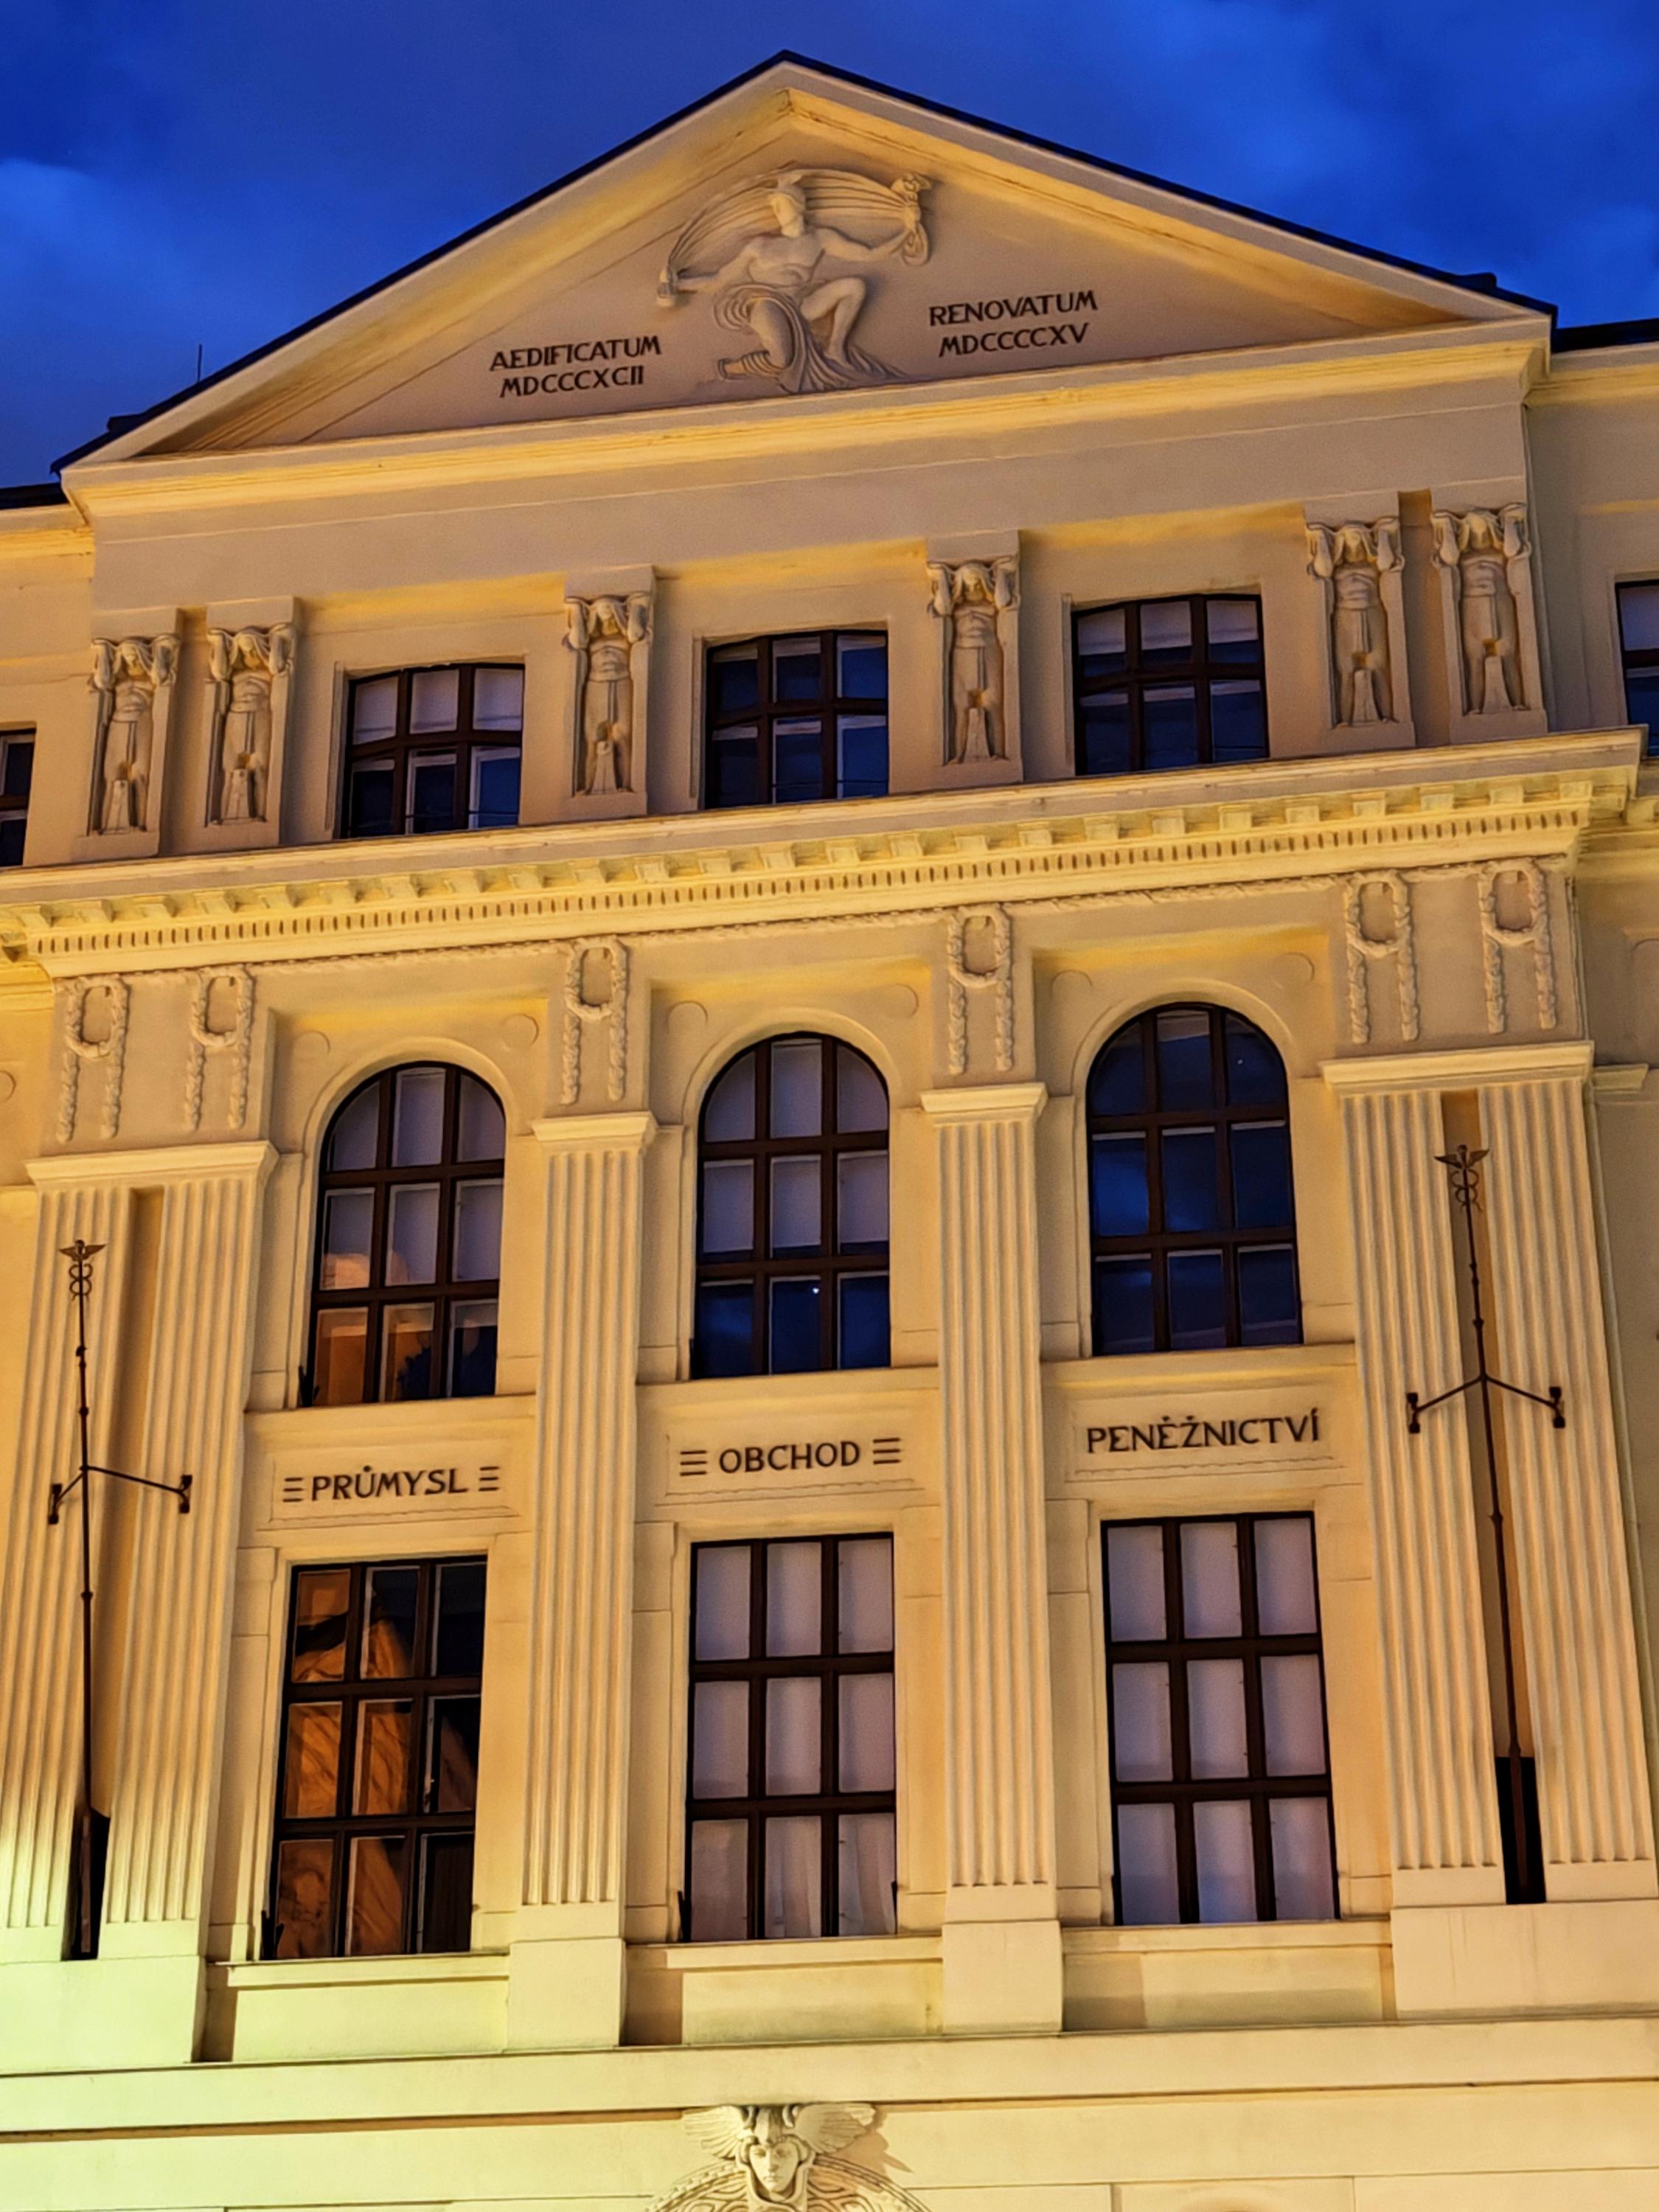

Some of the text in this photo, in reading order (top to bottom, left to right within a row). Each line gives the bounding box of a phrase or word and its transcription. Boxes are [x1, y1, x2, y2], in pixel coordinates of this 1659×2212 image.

[929, 291, 1098, 326] RENOVATUM
[490, 335, 661, 372] AEDIFICATUM
[939, 322, 1089, 358] MDCCCCXV
[499, 366, 644, 398] MDCCCXCII
[718, 1441, 861, 1474] OBCHOD
